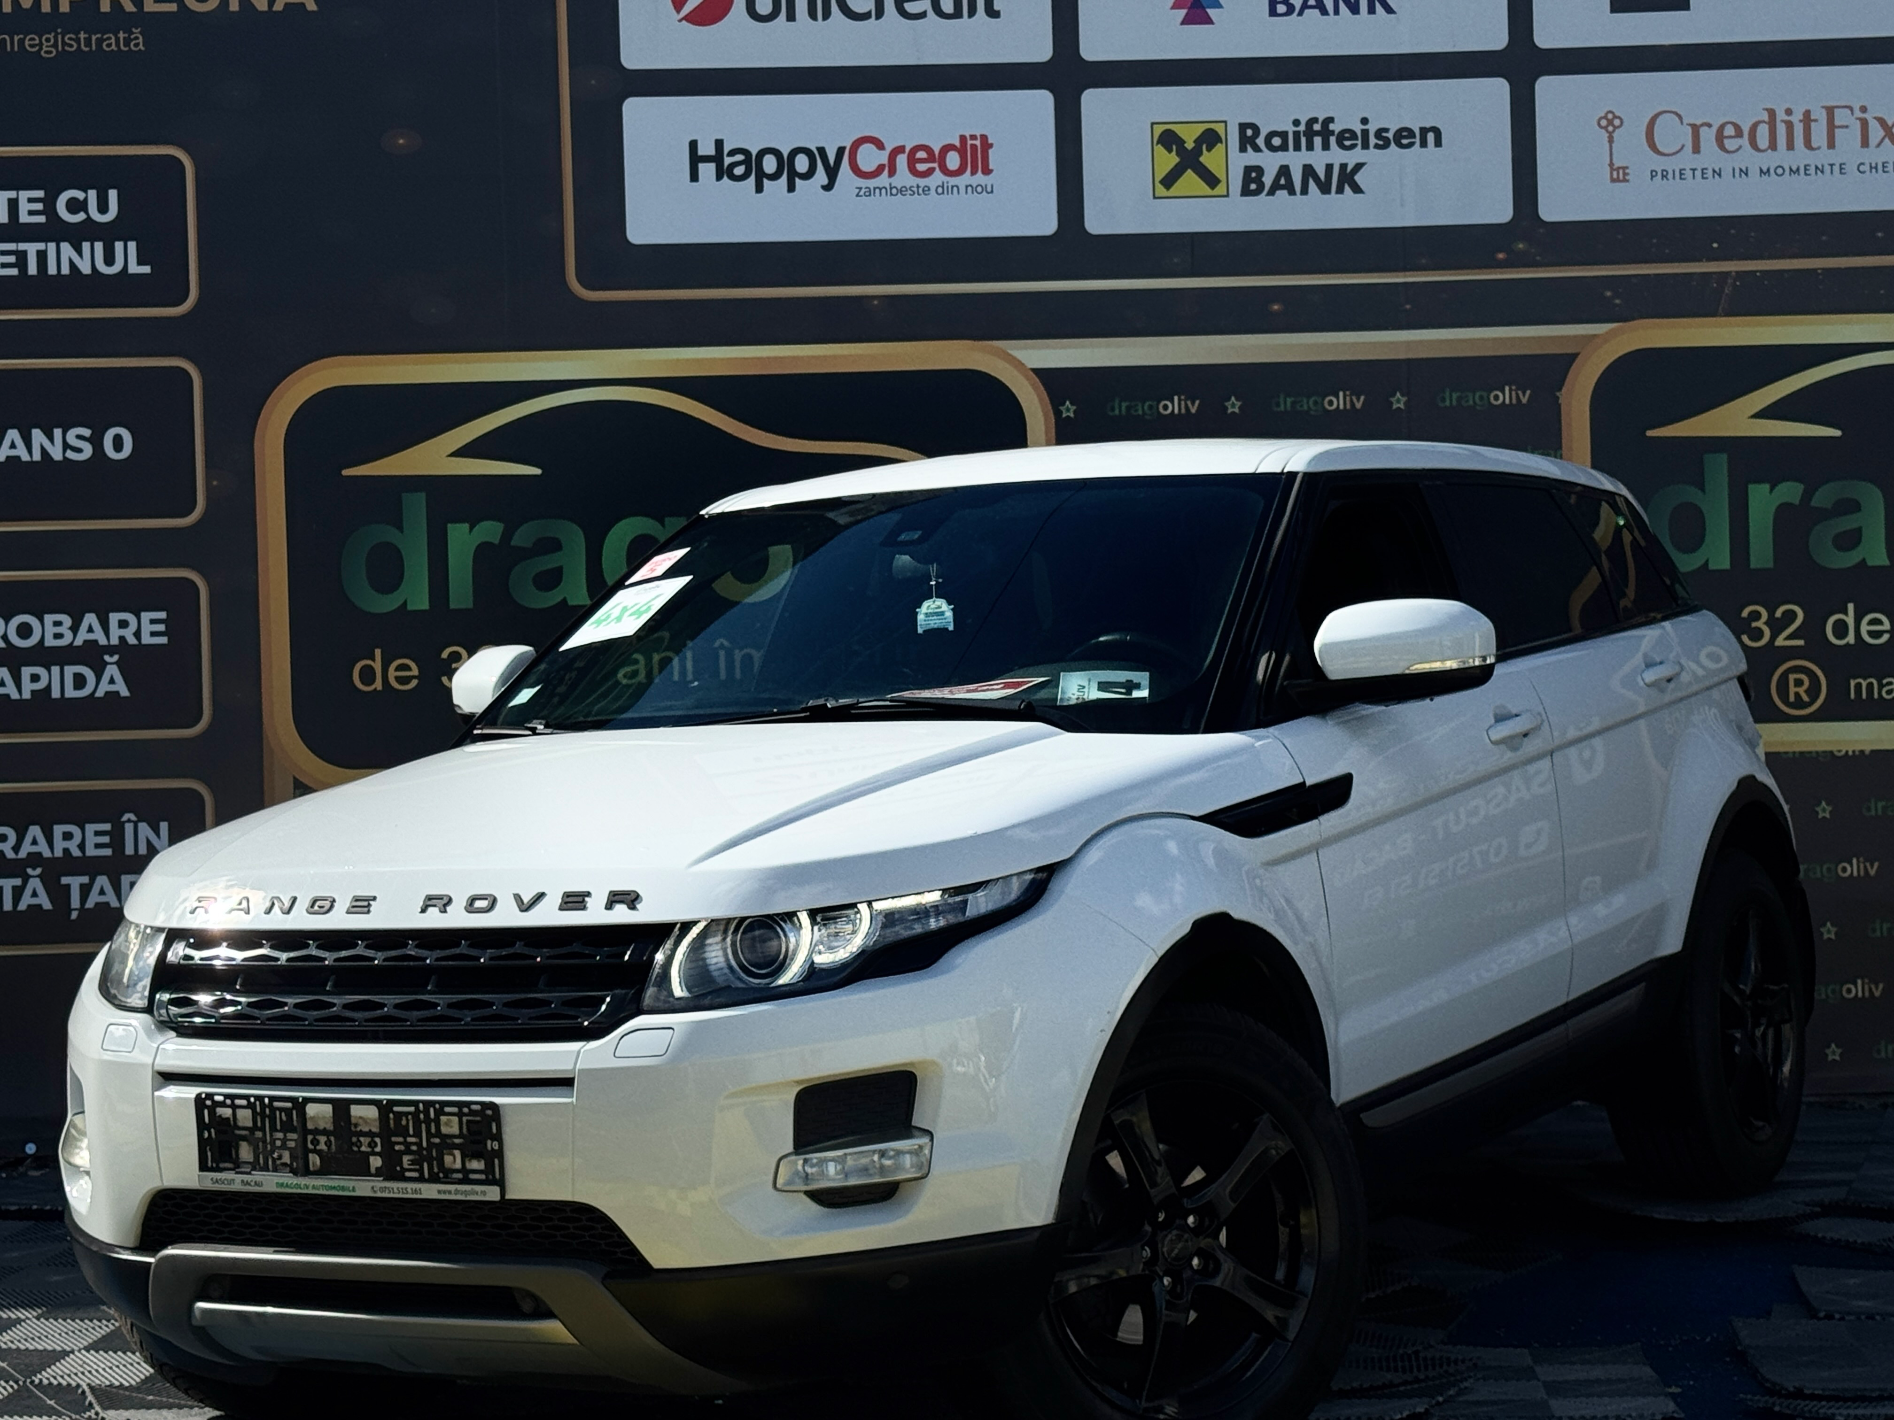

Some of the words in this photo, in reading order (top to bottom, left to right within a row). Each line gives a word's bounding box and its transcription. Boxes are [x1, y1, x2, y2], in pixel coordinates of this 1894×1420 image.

[1238, 117, 1443, 153] Raiffeisen
[1645, 105, 1894, 157] CreditFix
[688, 134, 994, 194] HappyCredit
[1240, 162, 1368, 197] BANK
[1650, 166, 1723, 181] PRIETEN
[1732, 165, 1749, 179] IN
[1759, 162, 1847, 178] MOMENTE
[1856, 160, 1894, 175] CHE
[0, 190, 46, 223] TE
[56, 189, 118, 223] CU
[855, 182, 931, 197] zambeste
[935, 181, 960, 196] din
[965, 183, 994, 195] nou
[1107, 395, 1200, 418] dragoliv
[1272, 388, 1365, 415] dragoliv
[1438, 385, 1531, 410] dragoliv
[0, 427, 93, 461] ANS
[103, 427, 133, 460] 0
[1647, 453, 1890, 574] dra
[0, 611, 168, 648] OBARE
[1740, 604, 1805, 647] 32
[1825, 603, 1891, 646] de
[352, 648, 420, 692] de
[617, 640, 694, 685] ani
[120, 813, 169, 855] ÎN
[0, 867, 53, 911] TĂ
[188, 895, 378, 916] RANGE
[419, 889, 643, 914] ROVER
[210, 1177, 235, 1187] SASCUT
[275, 1181, 309, 1191] DRAGOLIV
[311, 1183, 356, 1193] AUTOMOBILE
